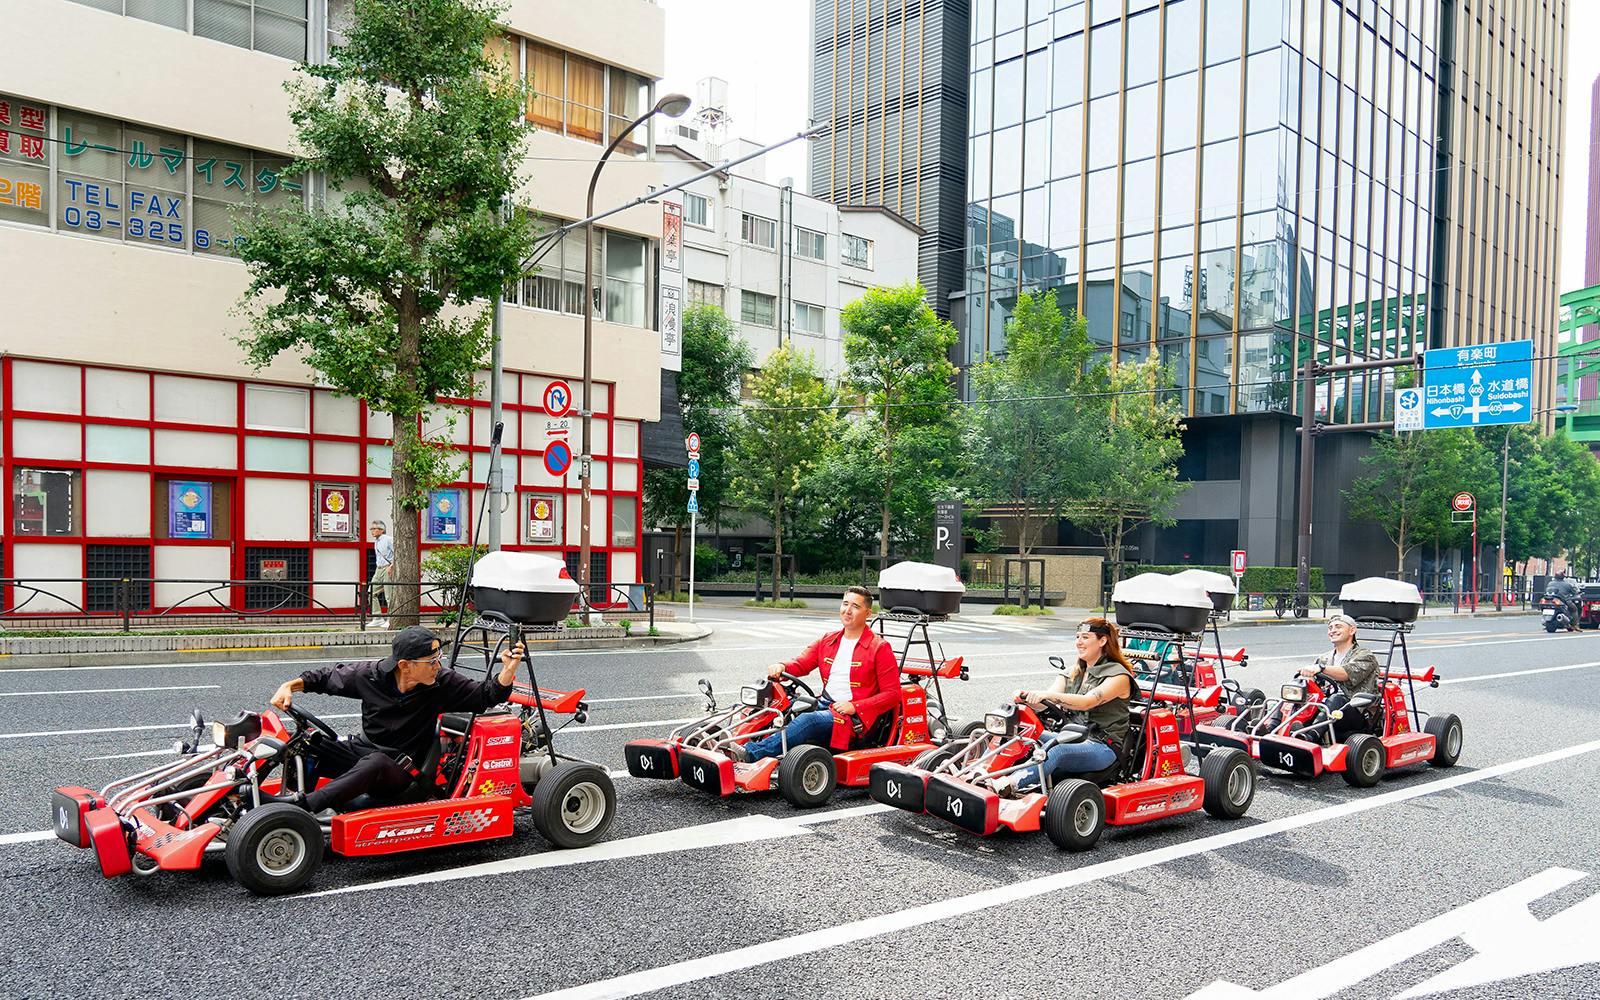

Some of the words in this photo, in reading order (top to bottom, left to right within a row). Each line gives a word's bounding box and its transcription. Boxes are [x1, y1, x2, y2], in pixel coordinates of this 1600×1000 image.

[64, 126, 303, 193] レールマイスター
[64, 179, 119, 209] TEL
[130, 191, 182, 219] FAX
[1457, 347, 1497, 361] 有楽町
[1427, 383, 1465, 397] 日本橋
[1487, 378, 1528, 392] 水道橋
[1426, 395, 1465, 404] Nihonbashi
[1487, 391, 1528, 401] Suidobashi
[1453, 407, 1461, 415] 17
[690, 464, 696, 474] P
[937, 526, 949, 550] P
[376, 823, 435, 839] Kart
[354, 833, 435, 848] streetpower
